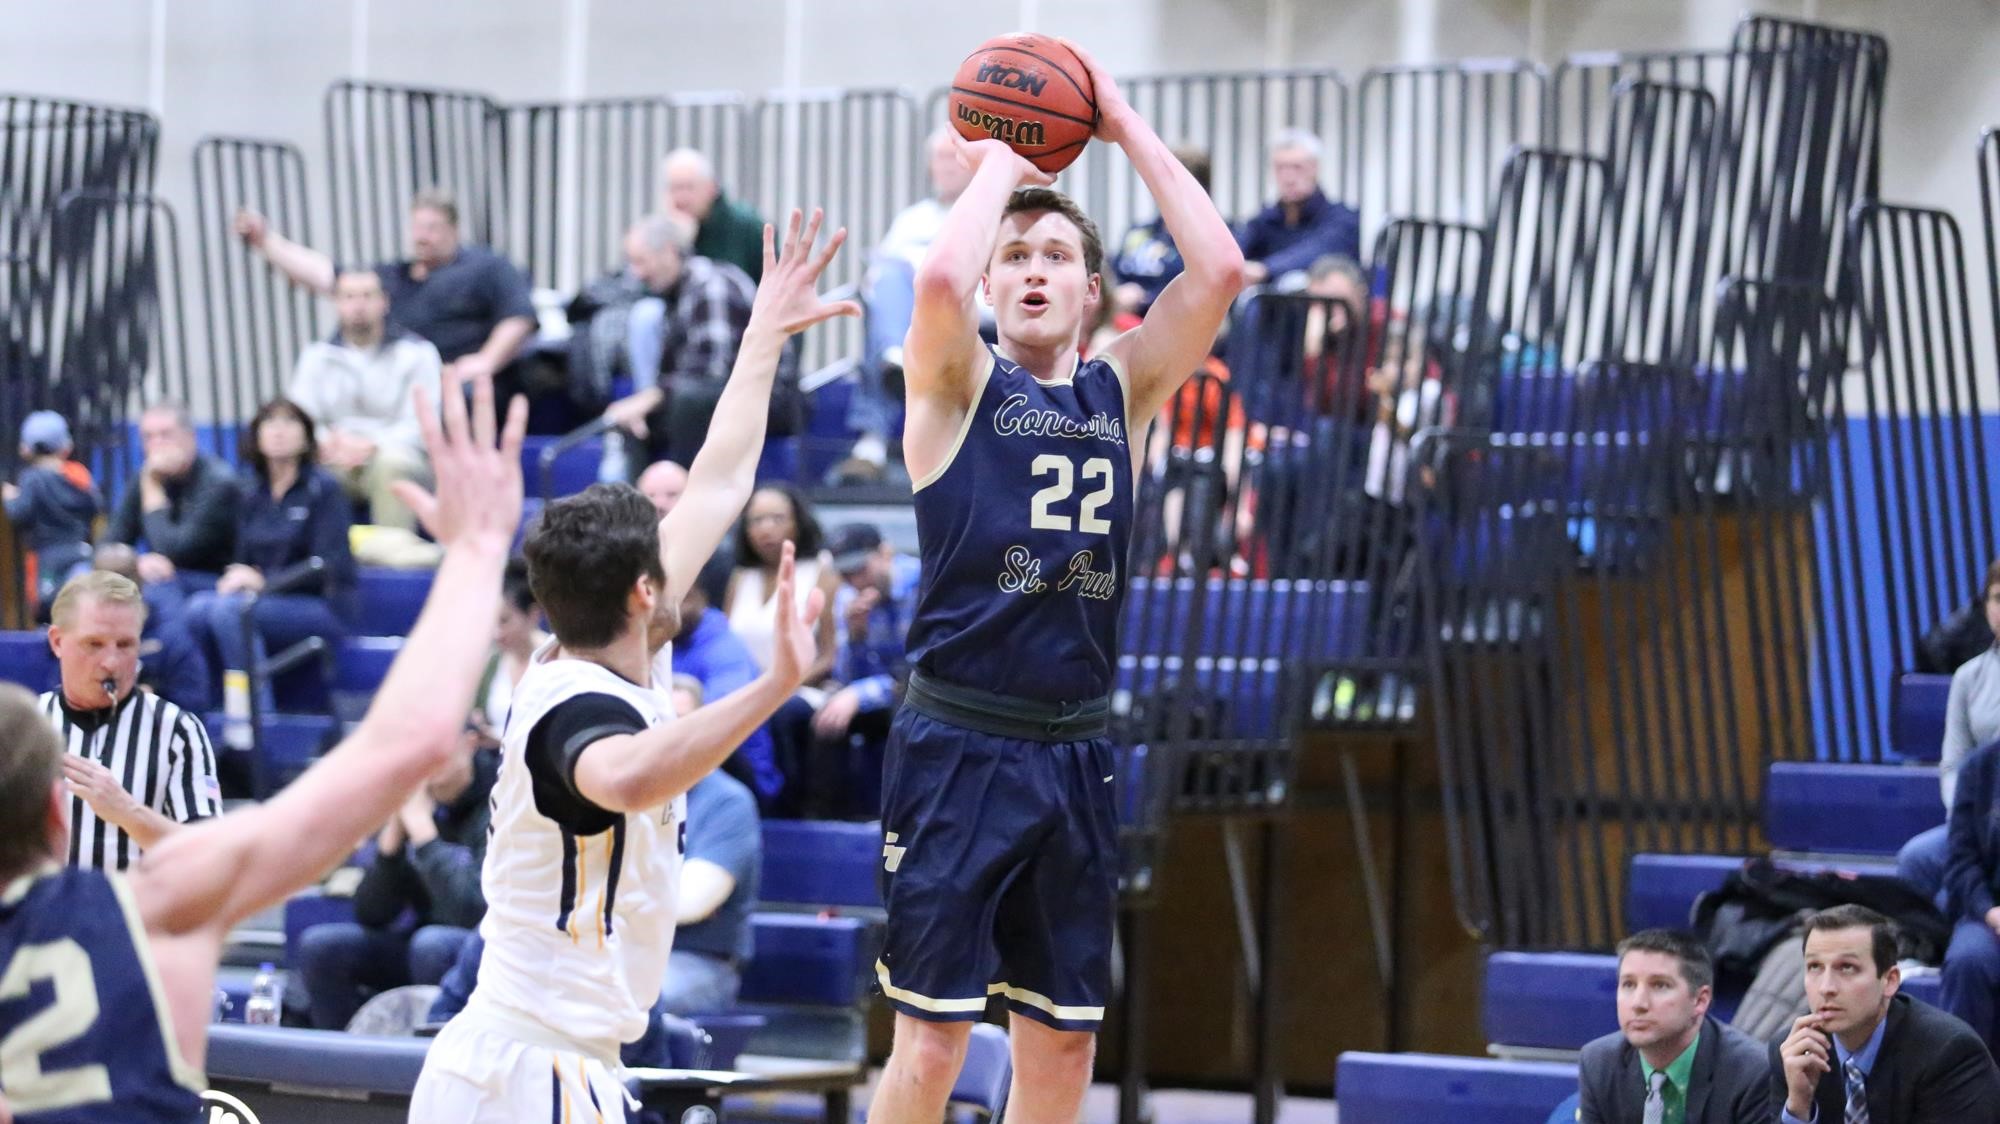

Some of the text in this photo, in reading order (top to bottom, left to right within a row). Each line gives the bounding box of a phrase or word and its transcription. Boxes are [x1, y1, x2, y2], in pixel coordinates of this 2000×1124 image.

[976, 63, 1048, 97] NCAA
[958, 102, 1046, 146] Wilson
[994, 393, 1125, 445] Concia
[1031, 454, 1114, 535] 22
[998, 545, 1047, 594] St.
[0, 938, 112, 1112] 2
